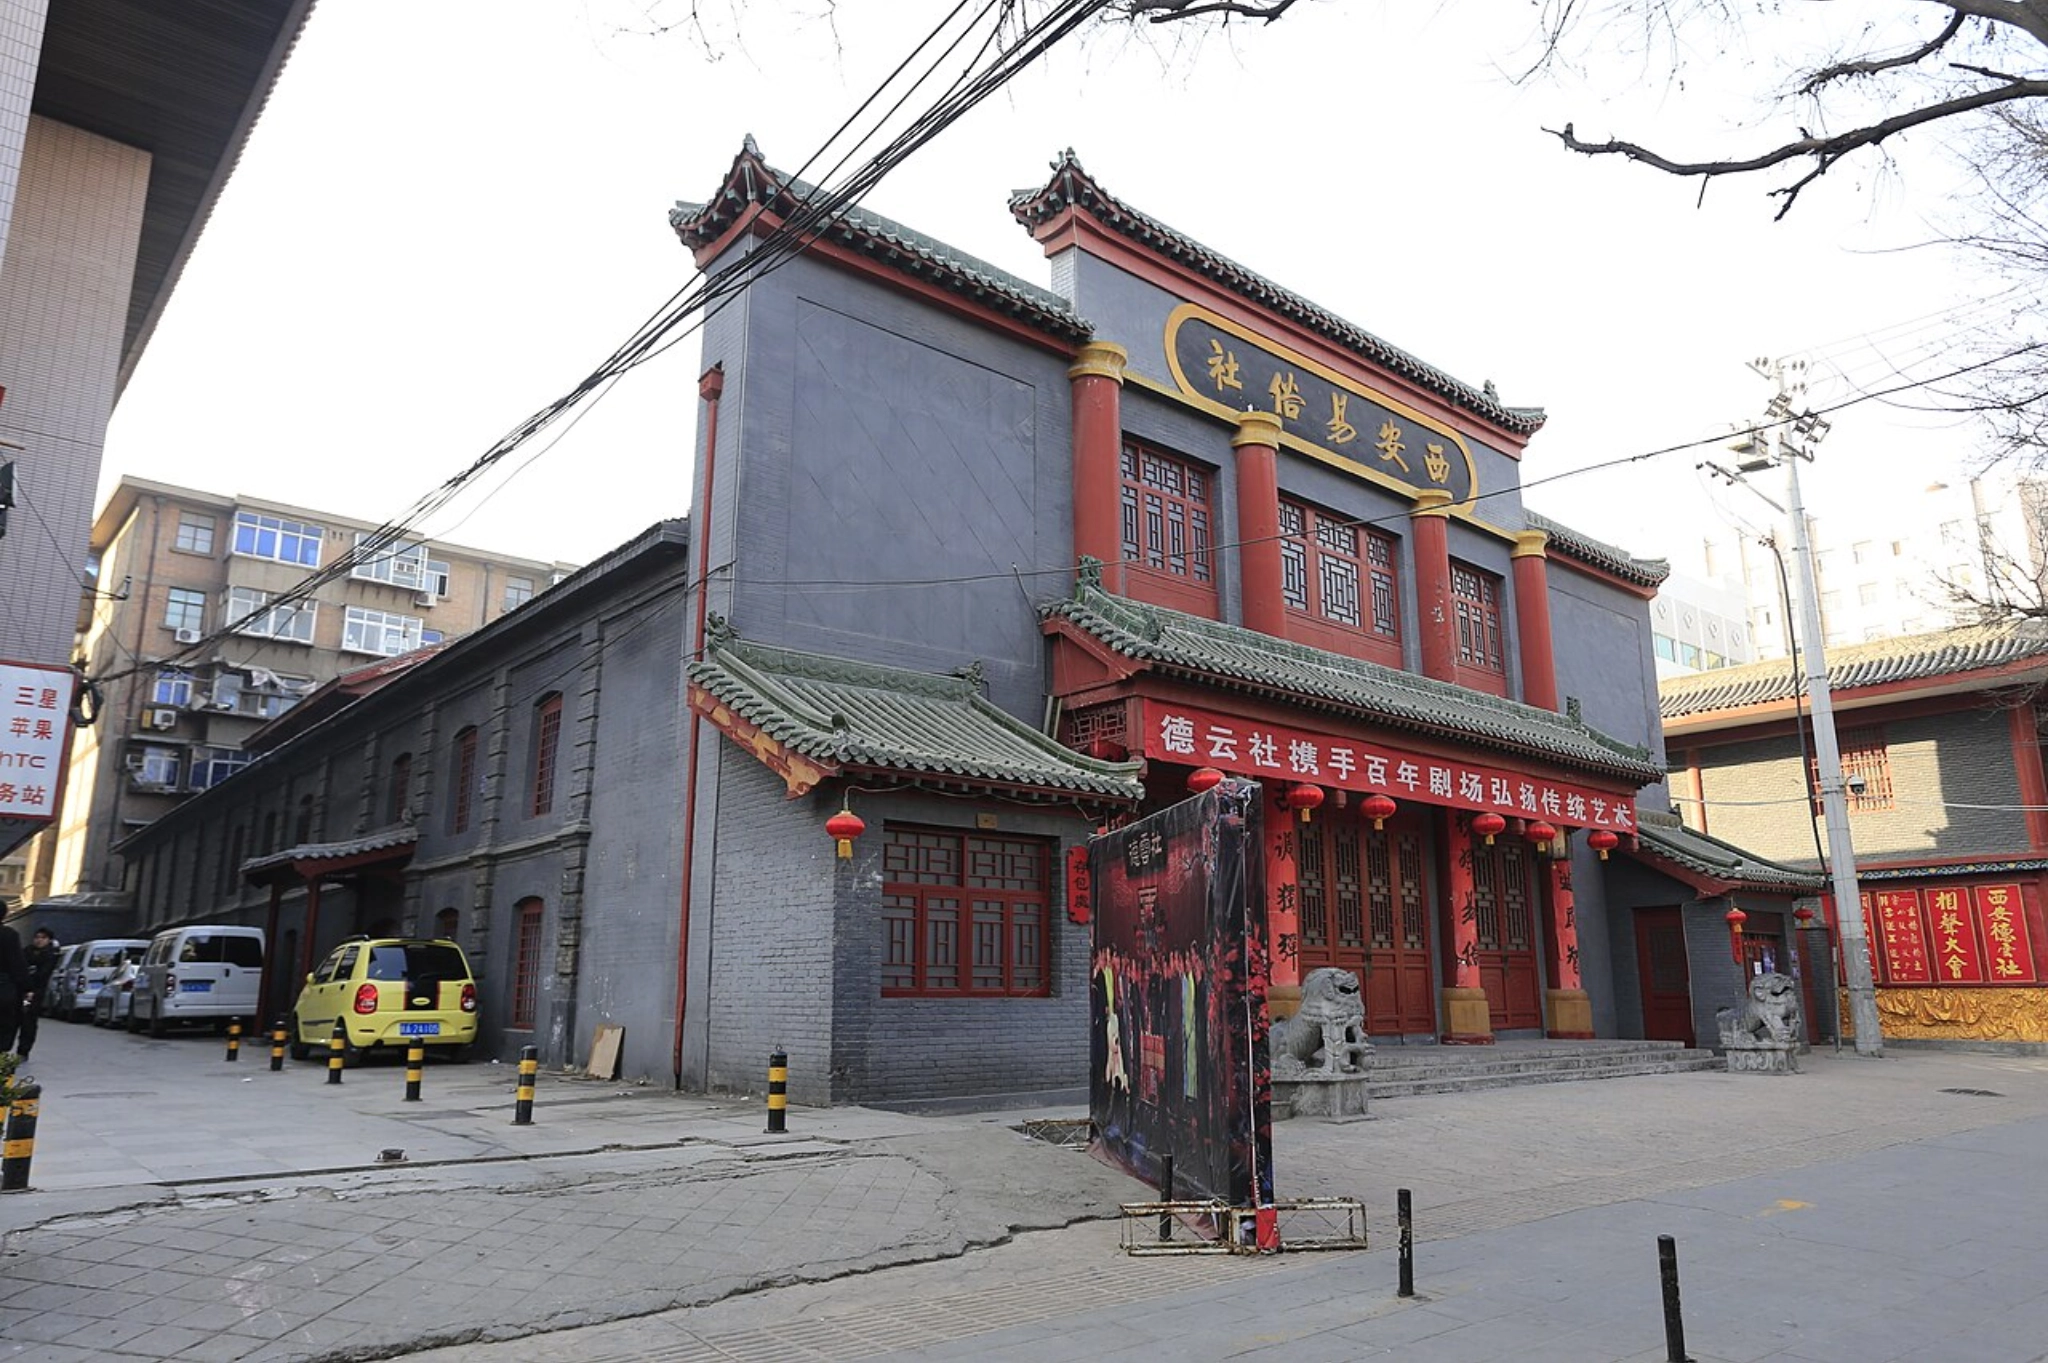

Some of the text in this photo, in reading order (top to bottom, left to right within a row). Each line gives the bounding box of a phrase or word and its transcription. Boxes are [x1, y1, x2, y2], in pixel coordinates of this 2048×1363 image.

[1208, 339, 1450, 484] 西安易俗社
[15, 686, 57, 710] 三星
[9, 716, 53, 740] 苹果
[0, 782, 46, 805] 务站
[1161, 714, 1633, 827] 德云社携手百年剧场弘扬传统艺术
[1935, 891, 1968, 979] 相聲大會
